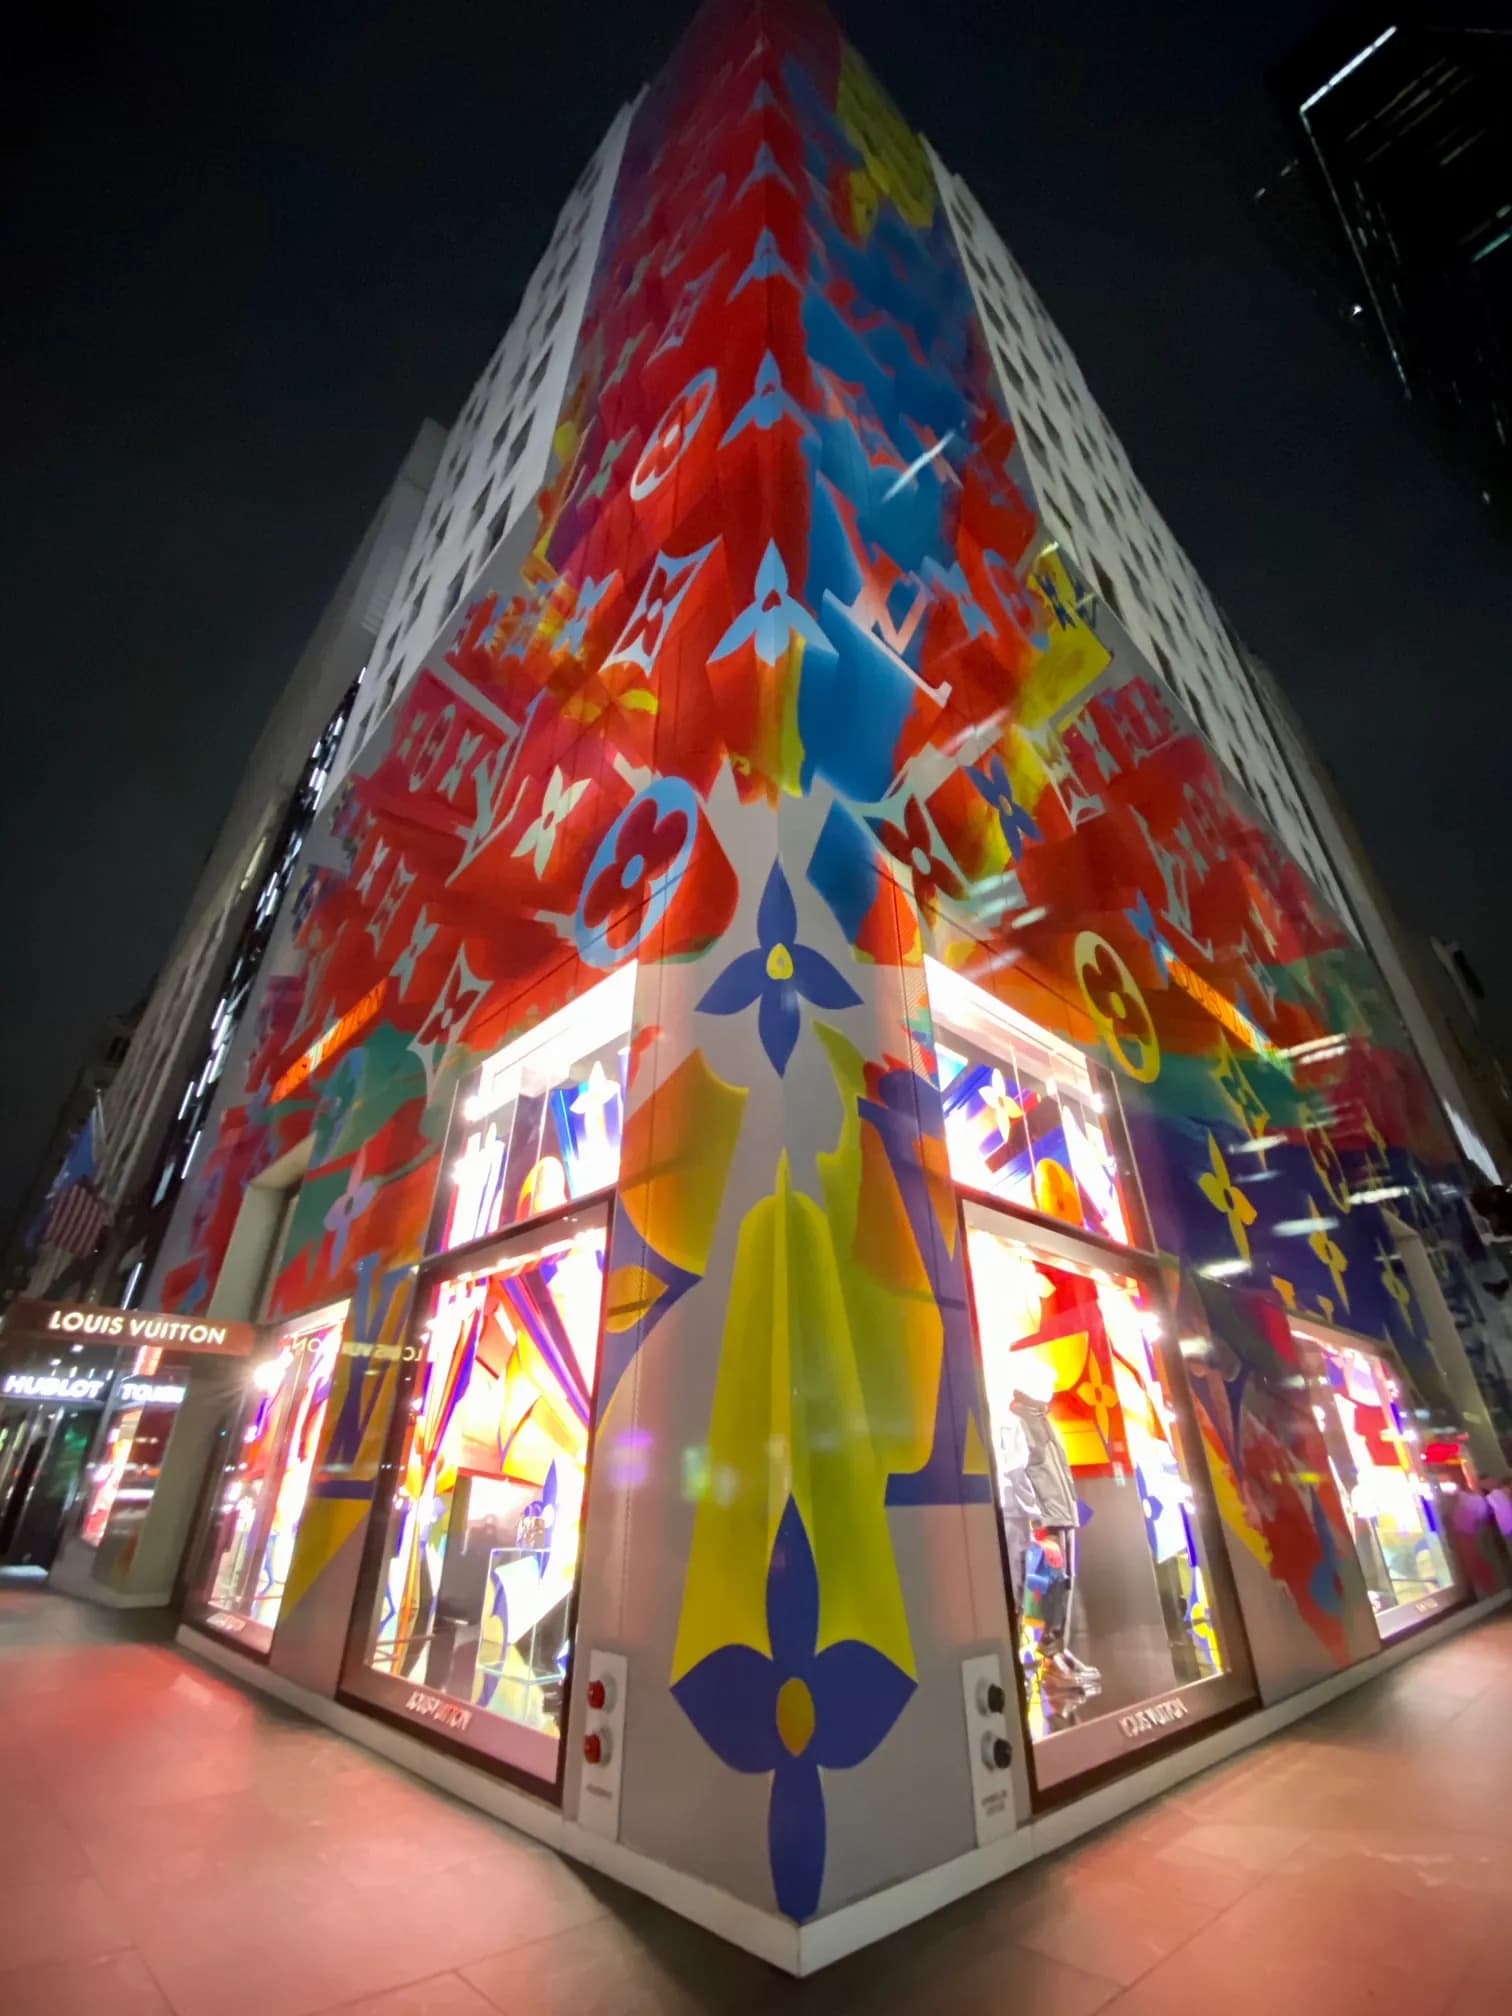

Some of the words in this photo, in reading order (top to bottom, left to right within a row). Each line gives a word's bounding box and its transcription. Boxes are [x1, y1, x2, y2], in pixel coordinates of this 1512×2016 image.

[48, 1310, 125, 1335] LOUIS
[130, 1318, 226, 1344] VUITTON
[4, 1375, 104, 1398] HUBLOT
